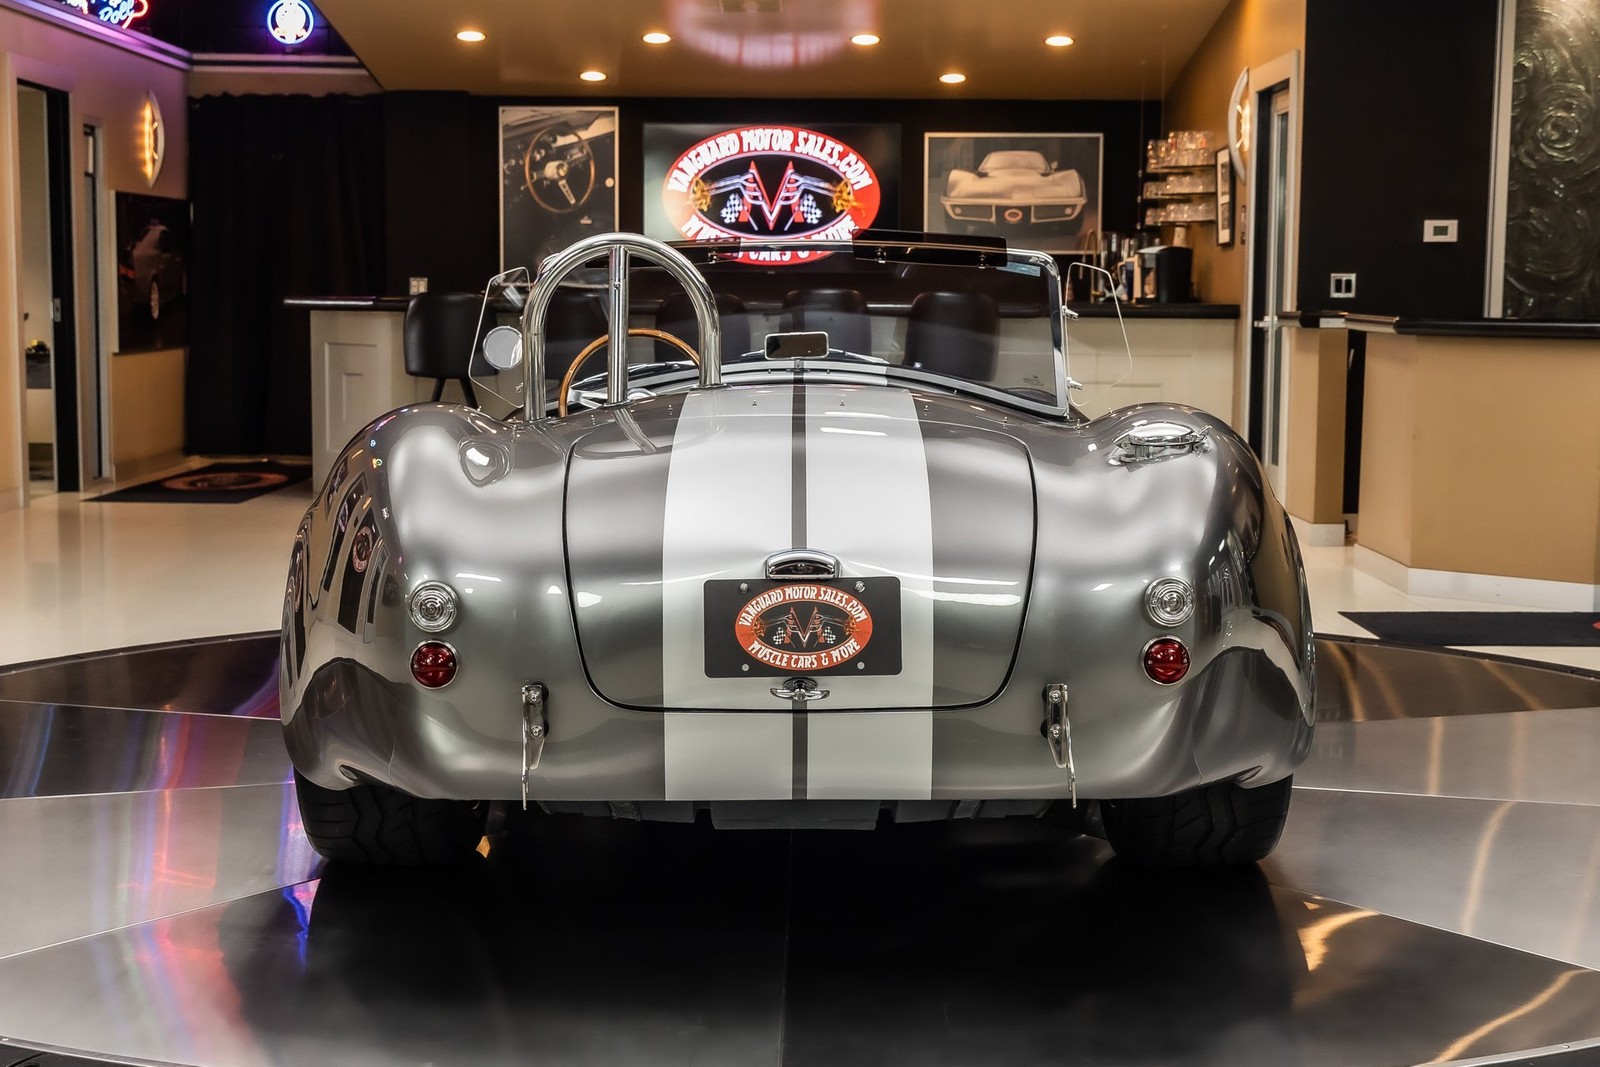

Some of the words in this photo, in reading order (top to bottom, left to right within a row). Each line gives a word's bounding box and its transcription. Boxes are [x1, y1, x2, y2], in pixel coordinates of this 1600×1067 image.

[666, 132, 741, 193] VANGUARD
[740, 128, 795, 152] MOTOR
[795, 130, 873, 190] SALES.COM
[738, 588, 784, 627] VANGUARD
[785, 585, 817, 600] MOTOR
[818, 587, 868, 622] SALES.COM
[747, 640, 789, 667] MUSCLE
[790, 654, 818, 669] CARS
[821, 653, 831, 666] &
[831, 638, 861, 662] MORE
